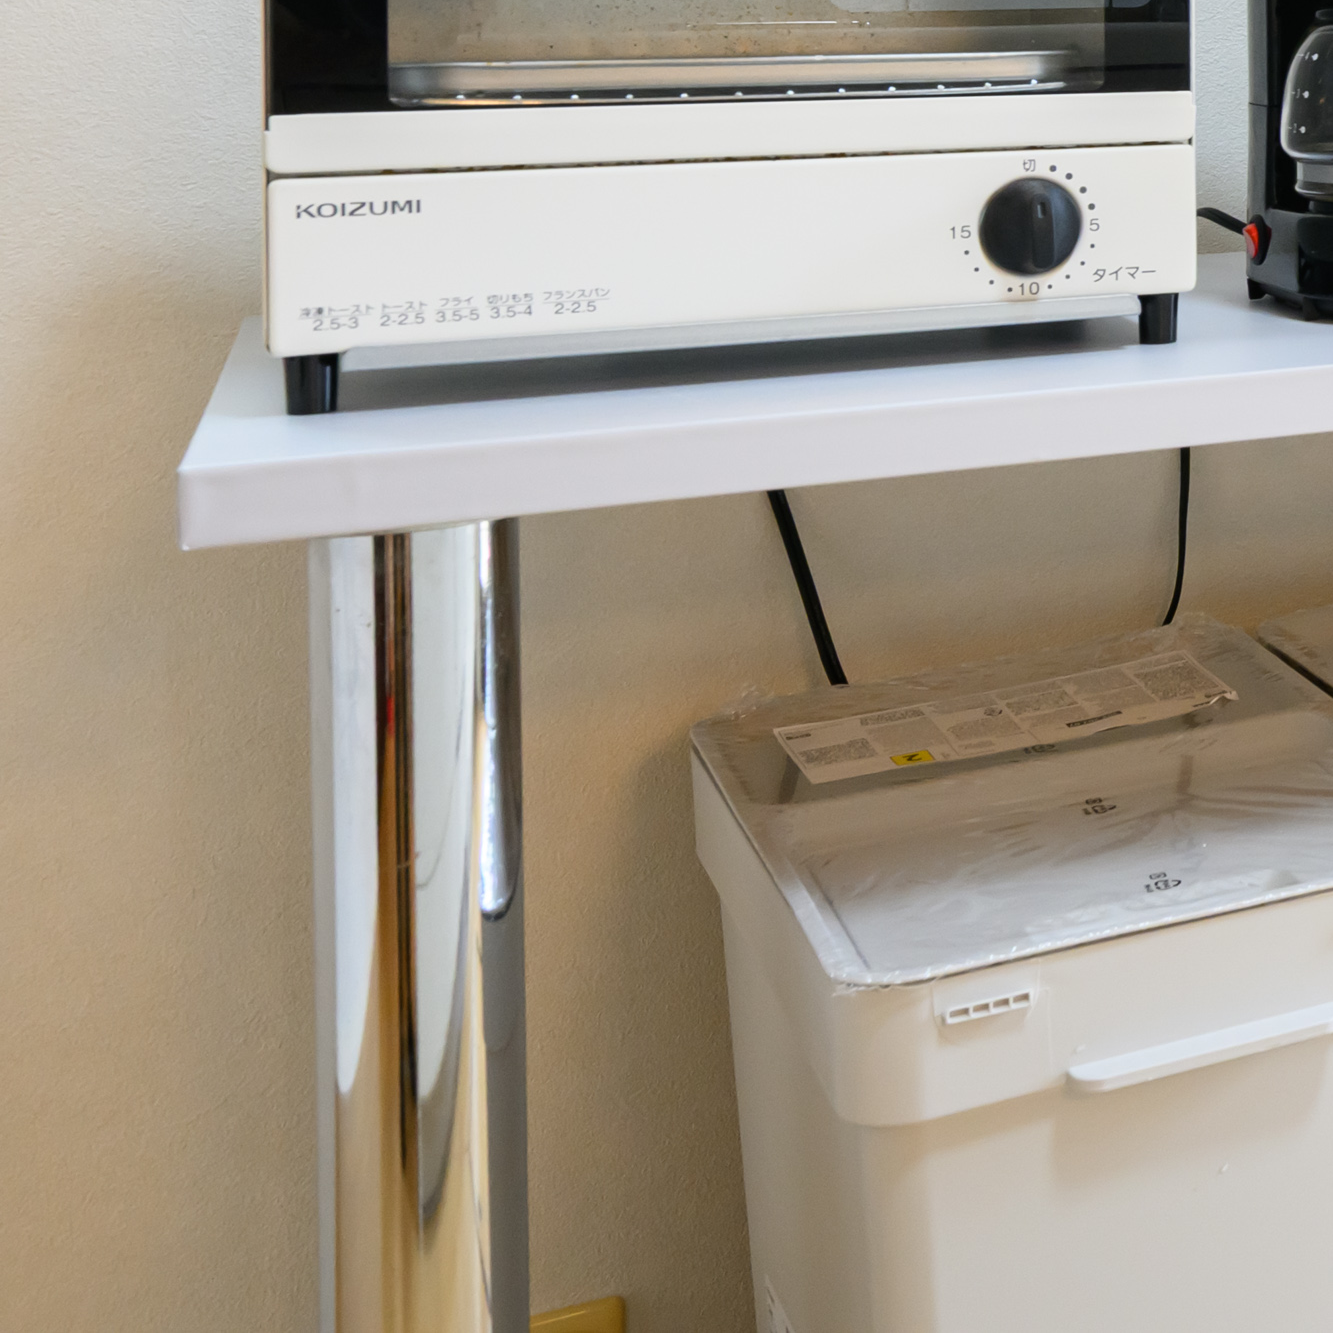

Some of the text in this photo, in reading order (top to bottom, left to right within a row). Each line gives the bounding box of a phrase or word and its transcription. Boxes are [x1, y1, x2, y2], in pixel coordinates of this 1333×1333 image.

[1022, 159, 1036, 172] 切
[296, 199, 421, 219] KOIZUMI
[950, 225, 972, 239] 15
[1089, 218, 1100, 232] 5
[1092, 266, 1157, 283] タイマー
[1018, 281, 1040, 296] 10
[380, 300, 428, 312] トースト
[439, 296, 474, 308] フライ
[487, 293, 534, 305] 切りもち
[542, 287, 610, 300] フランスパン
[313, 299, 598, 332] 2.5-3 2-2.5 3.5-5 3.5-4 2-2.5
